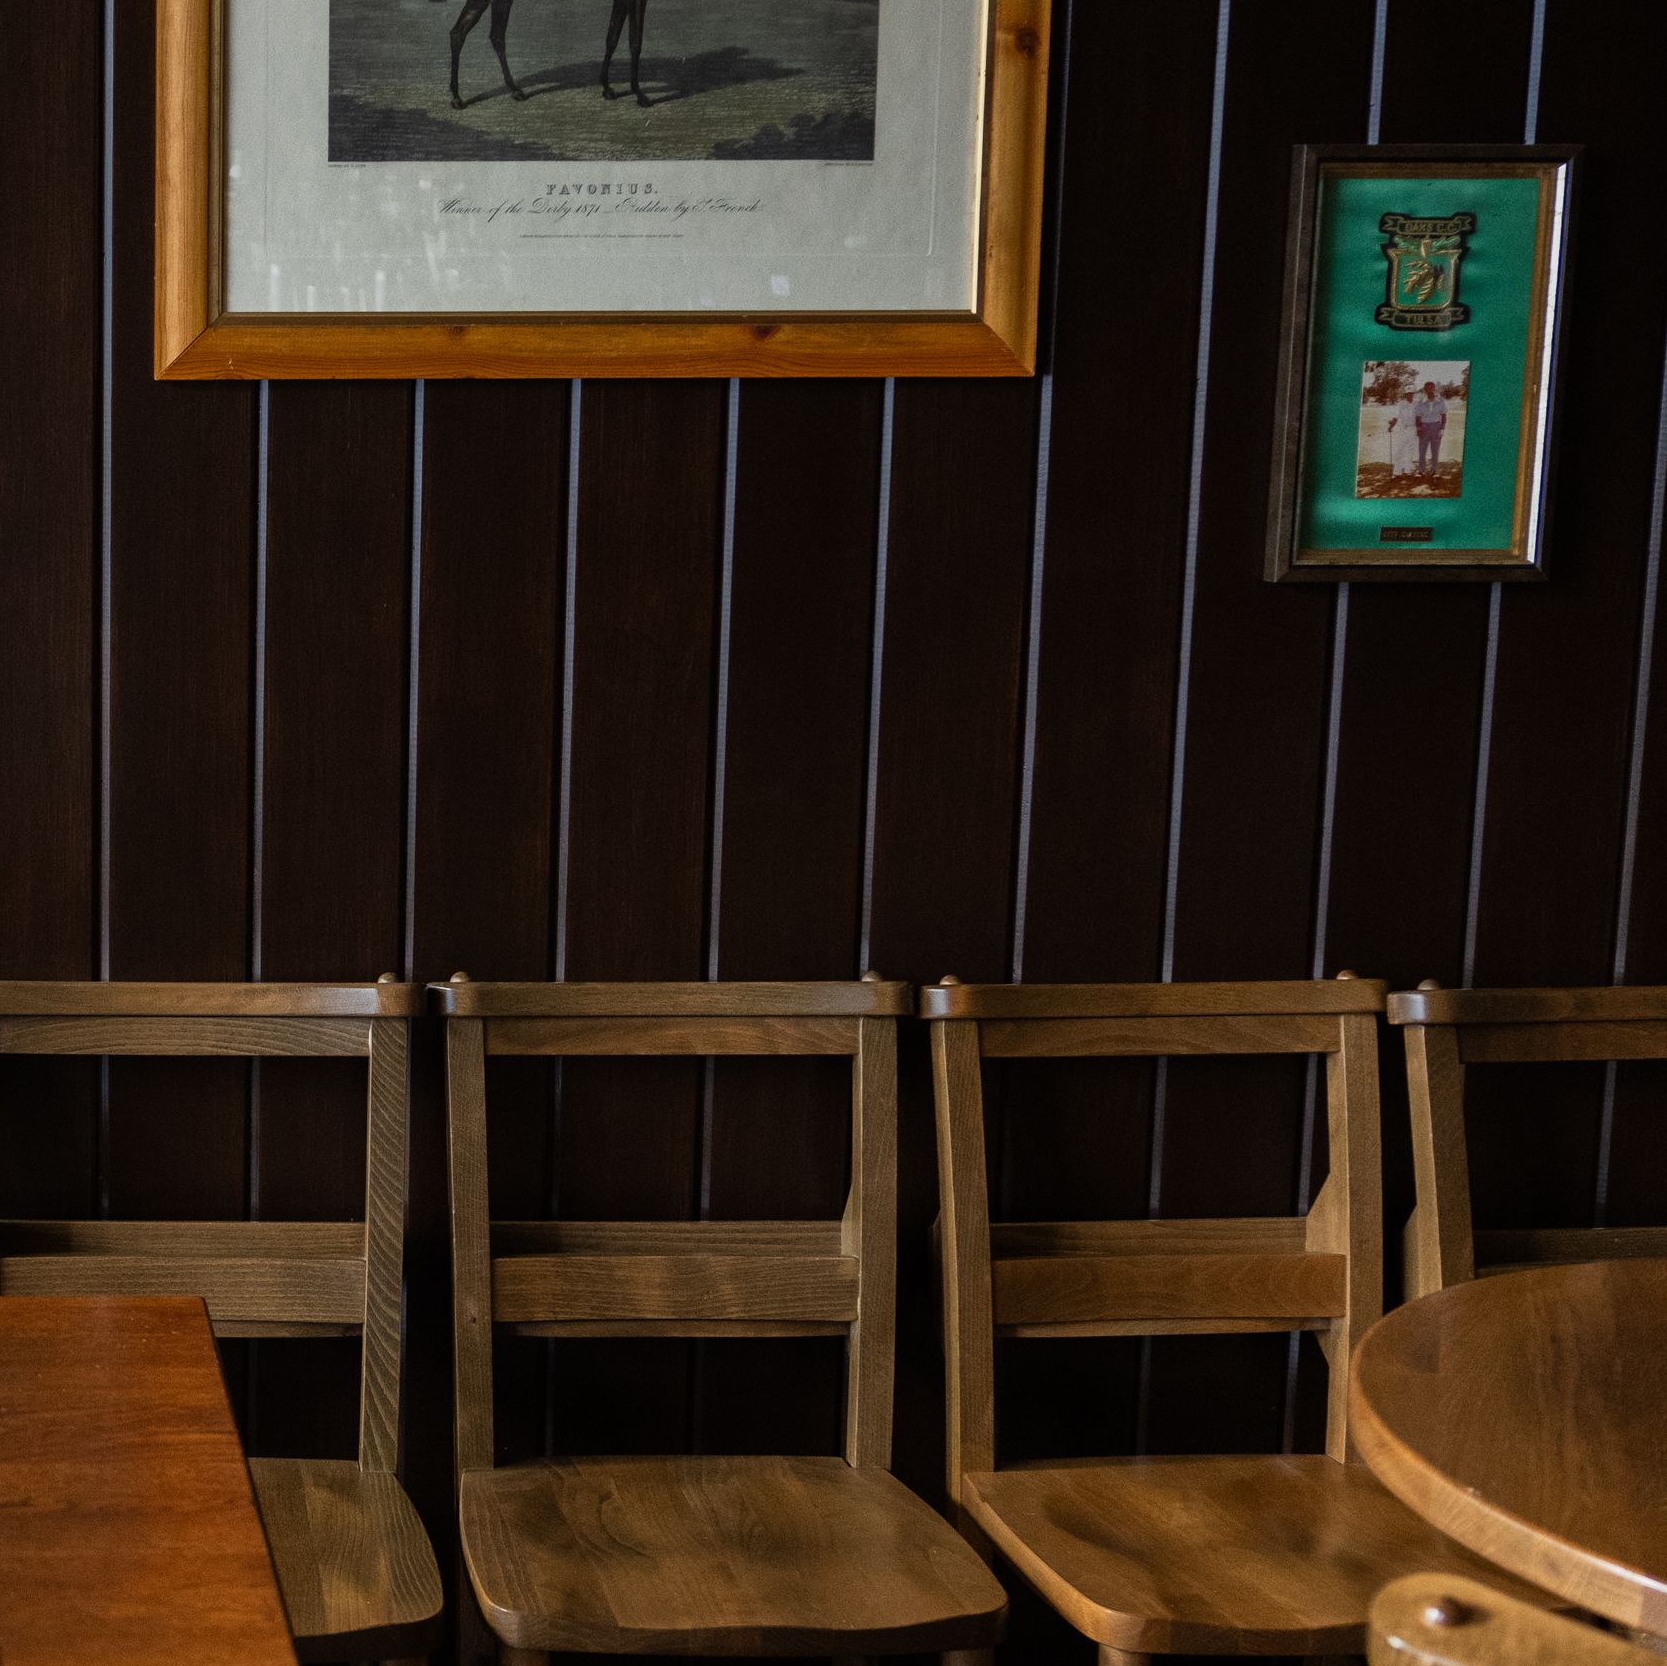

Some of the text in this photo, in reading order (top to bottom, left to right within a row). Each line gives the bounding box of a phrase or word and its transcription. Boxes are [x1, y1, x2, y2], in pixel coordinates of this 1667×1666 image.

[437, 196, 482, 214] Winner
[487, 199, 509, 223] of
[504, 199, 525, 214] the
[527, 197, 571, 223] Derby
[575, 203, 601, 217] 1871
[670, 199, 690, 222] by
[1406, 314, 1442, 326] TULSA
